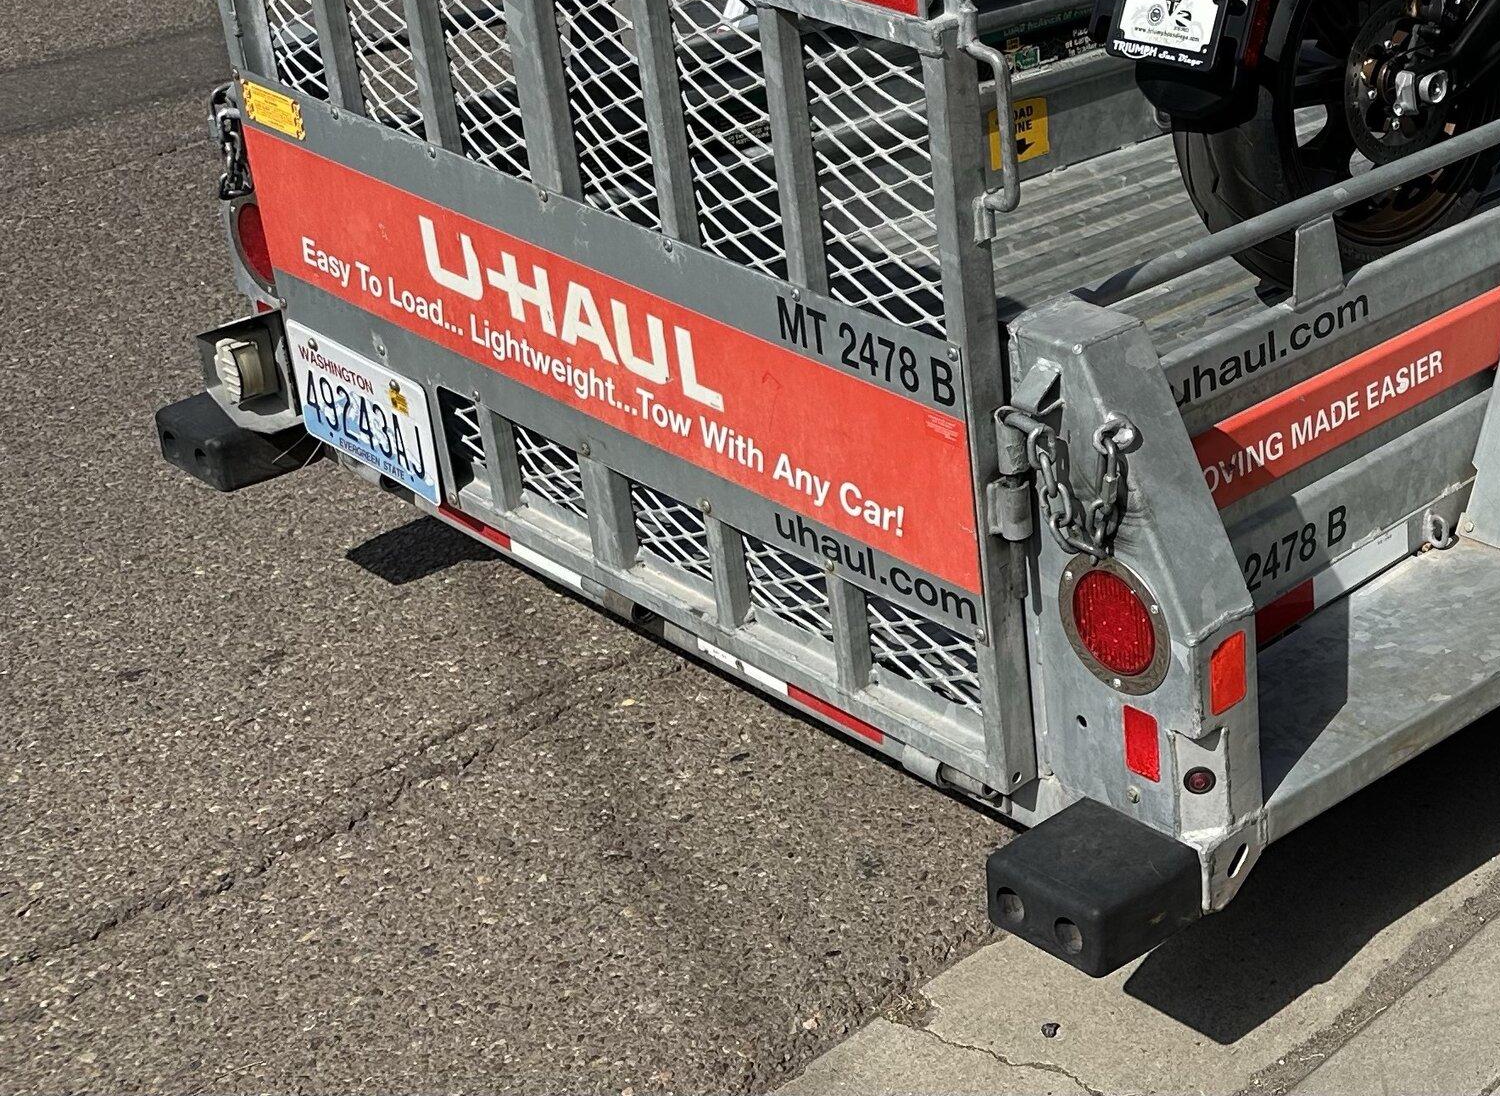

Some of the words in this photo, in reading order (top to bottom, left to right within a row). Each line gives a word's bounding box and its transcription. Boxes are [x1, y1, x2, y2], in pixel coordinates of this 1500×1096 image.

[1113, 40, 1159, 59] TRIUMPH
[1158, 50, 1176, 62] San
[1178, 53, 1204, 67] Diego
[1013, 105, 1034, 121] OAD
[1014, 119, 1033, 134] INE
[417, 214, 726, 412] U-HAUL
[776, 295, 828, 356] MT
[839, 322, 920, 394] 2478
[930, 356, 957, 408] B
[1174, 293, 1370, 405] uhaul.com
[298, 344, 375, 395] WASHINGTON
[301, 236, 351, 288] Easy
[355, 260, 383, 298] To
[388, 276, 464, 336] Load...
[699, 415, 765, 474] With
[772, 453, 831, 508] Any
[840, 481, 905, 537] Car!
[1202, 432, 1285, 493] OVING
[1291, 391, 1360, 451] MADE
[1366, 350, 1444, 411] EASIER
[306, 370, 426, 480] 49243AJ
[339, 436, 381, 467] EVERGREEN
[383, 461, 405, 481] STATE
[774, 512, 979, 626] uhaul.com
[1244, 522, 1317, 594] 2478
[1327, 504, 1348, 548] B
